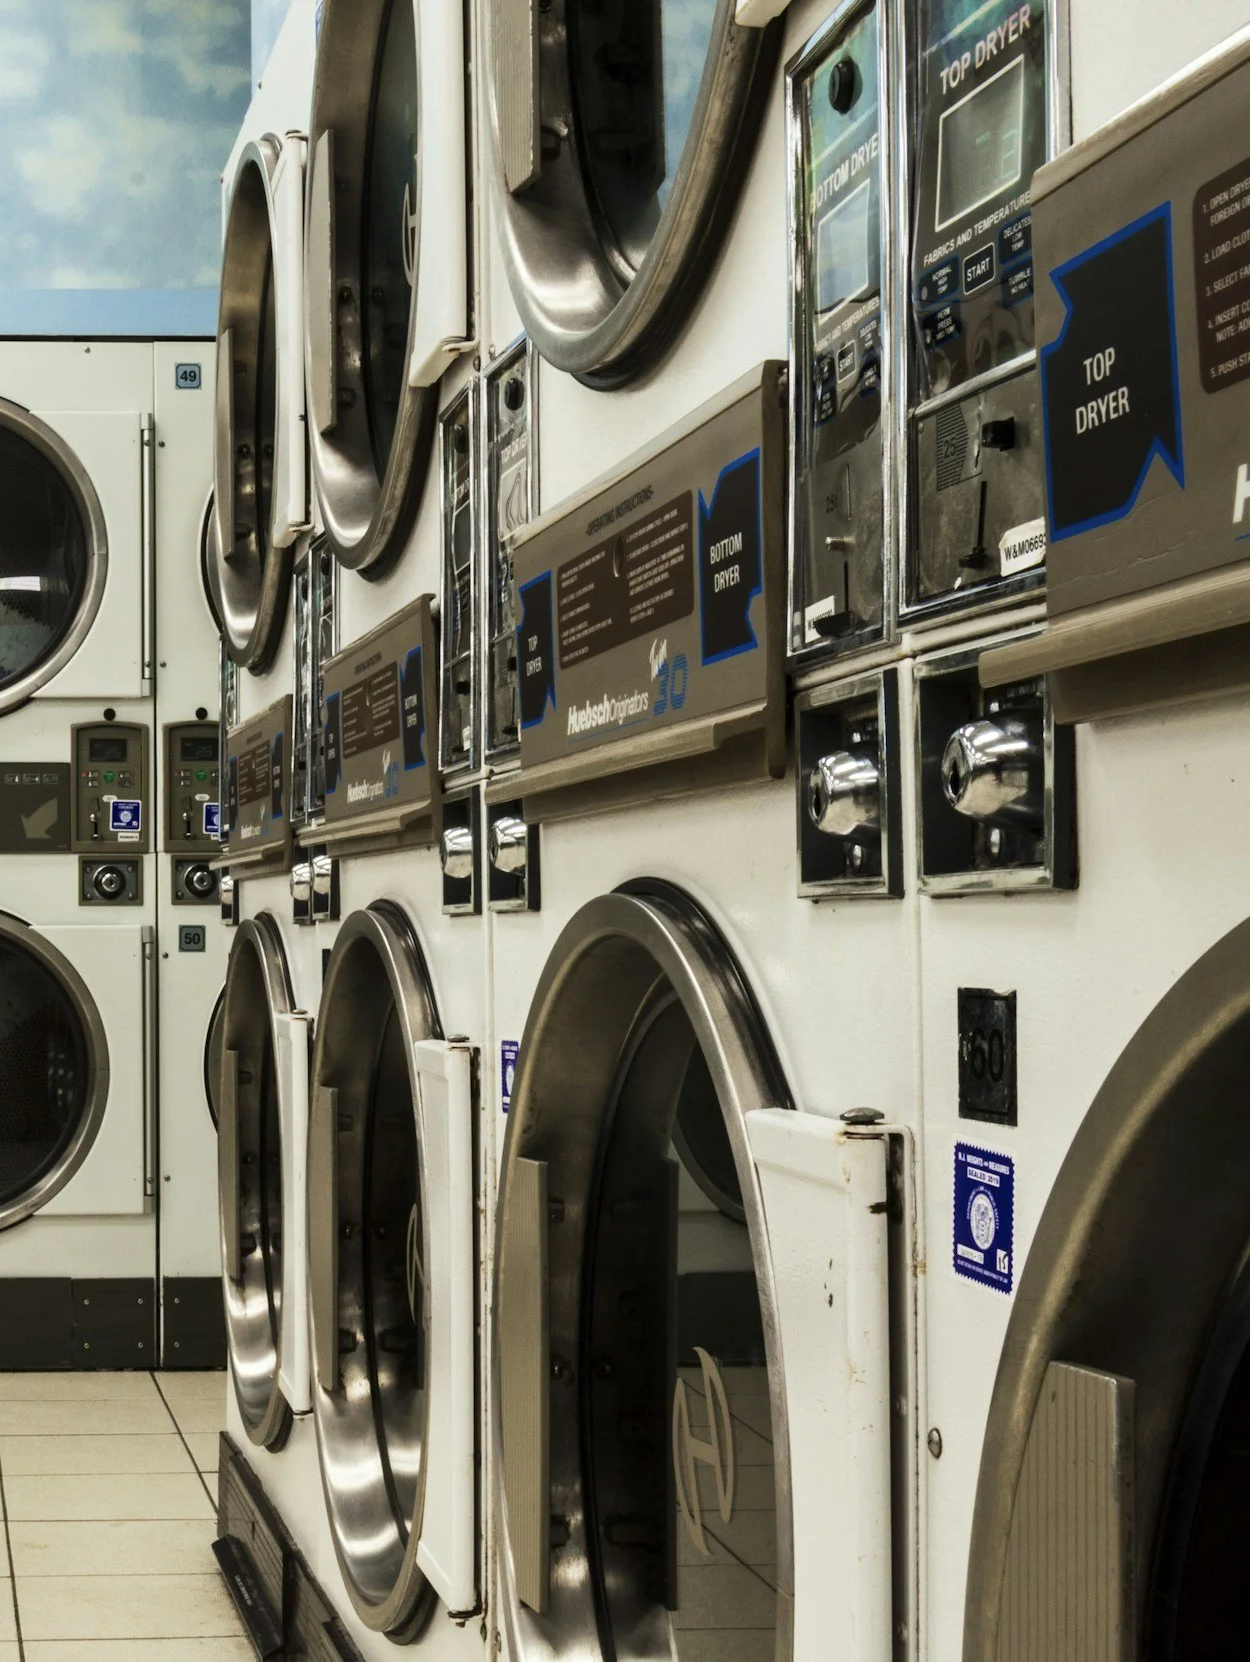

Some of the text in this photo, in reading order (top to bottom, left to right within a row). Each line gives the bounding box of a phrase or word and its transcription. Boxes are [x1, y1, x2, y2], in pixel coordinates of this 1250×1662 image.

[939, 3, 1031, 95] TOP DRYER
[851, 131, 879, 177] DRYE
[1210, 190, 1229, 210] OPEN
[1210, 201, 1241, 227] FOREIGN
[923, 190, 1031, 267] FABRICS AND TEMPERATURE
[1212, 240, 1231, 260] LOAD
[966, 257, 991, 282] START
[1213, 271, 1239, 293] SELECT
[1215, 305, 1240, 326] INSERT
[180, 370, 197, 382] 49
[1083, 347, 1116, 386] TOP
[1217, 358, 1238, 376] PUSH
[1075, 386, 1130, 435] DRYER
[710, 531, 742, 565] BOTTOM
[714, 564, 740, 593] DRYER
[528, 634, 538, 653] TOP
[526, 656, 543, 677] DRYER
[184, 933, 200, 945] 50
[971, 1028, 1004, 1082] 60
[968, 1168, 986, 1181] SEALED
